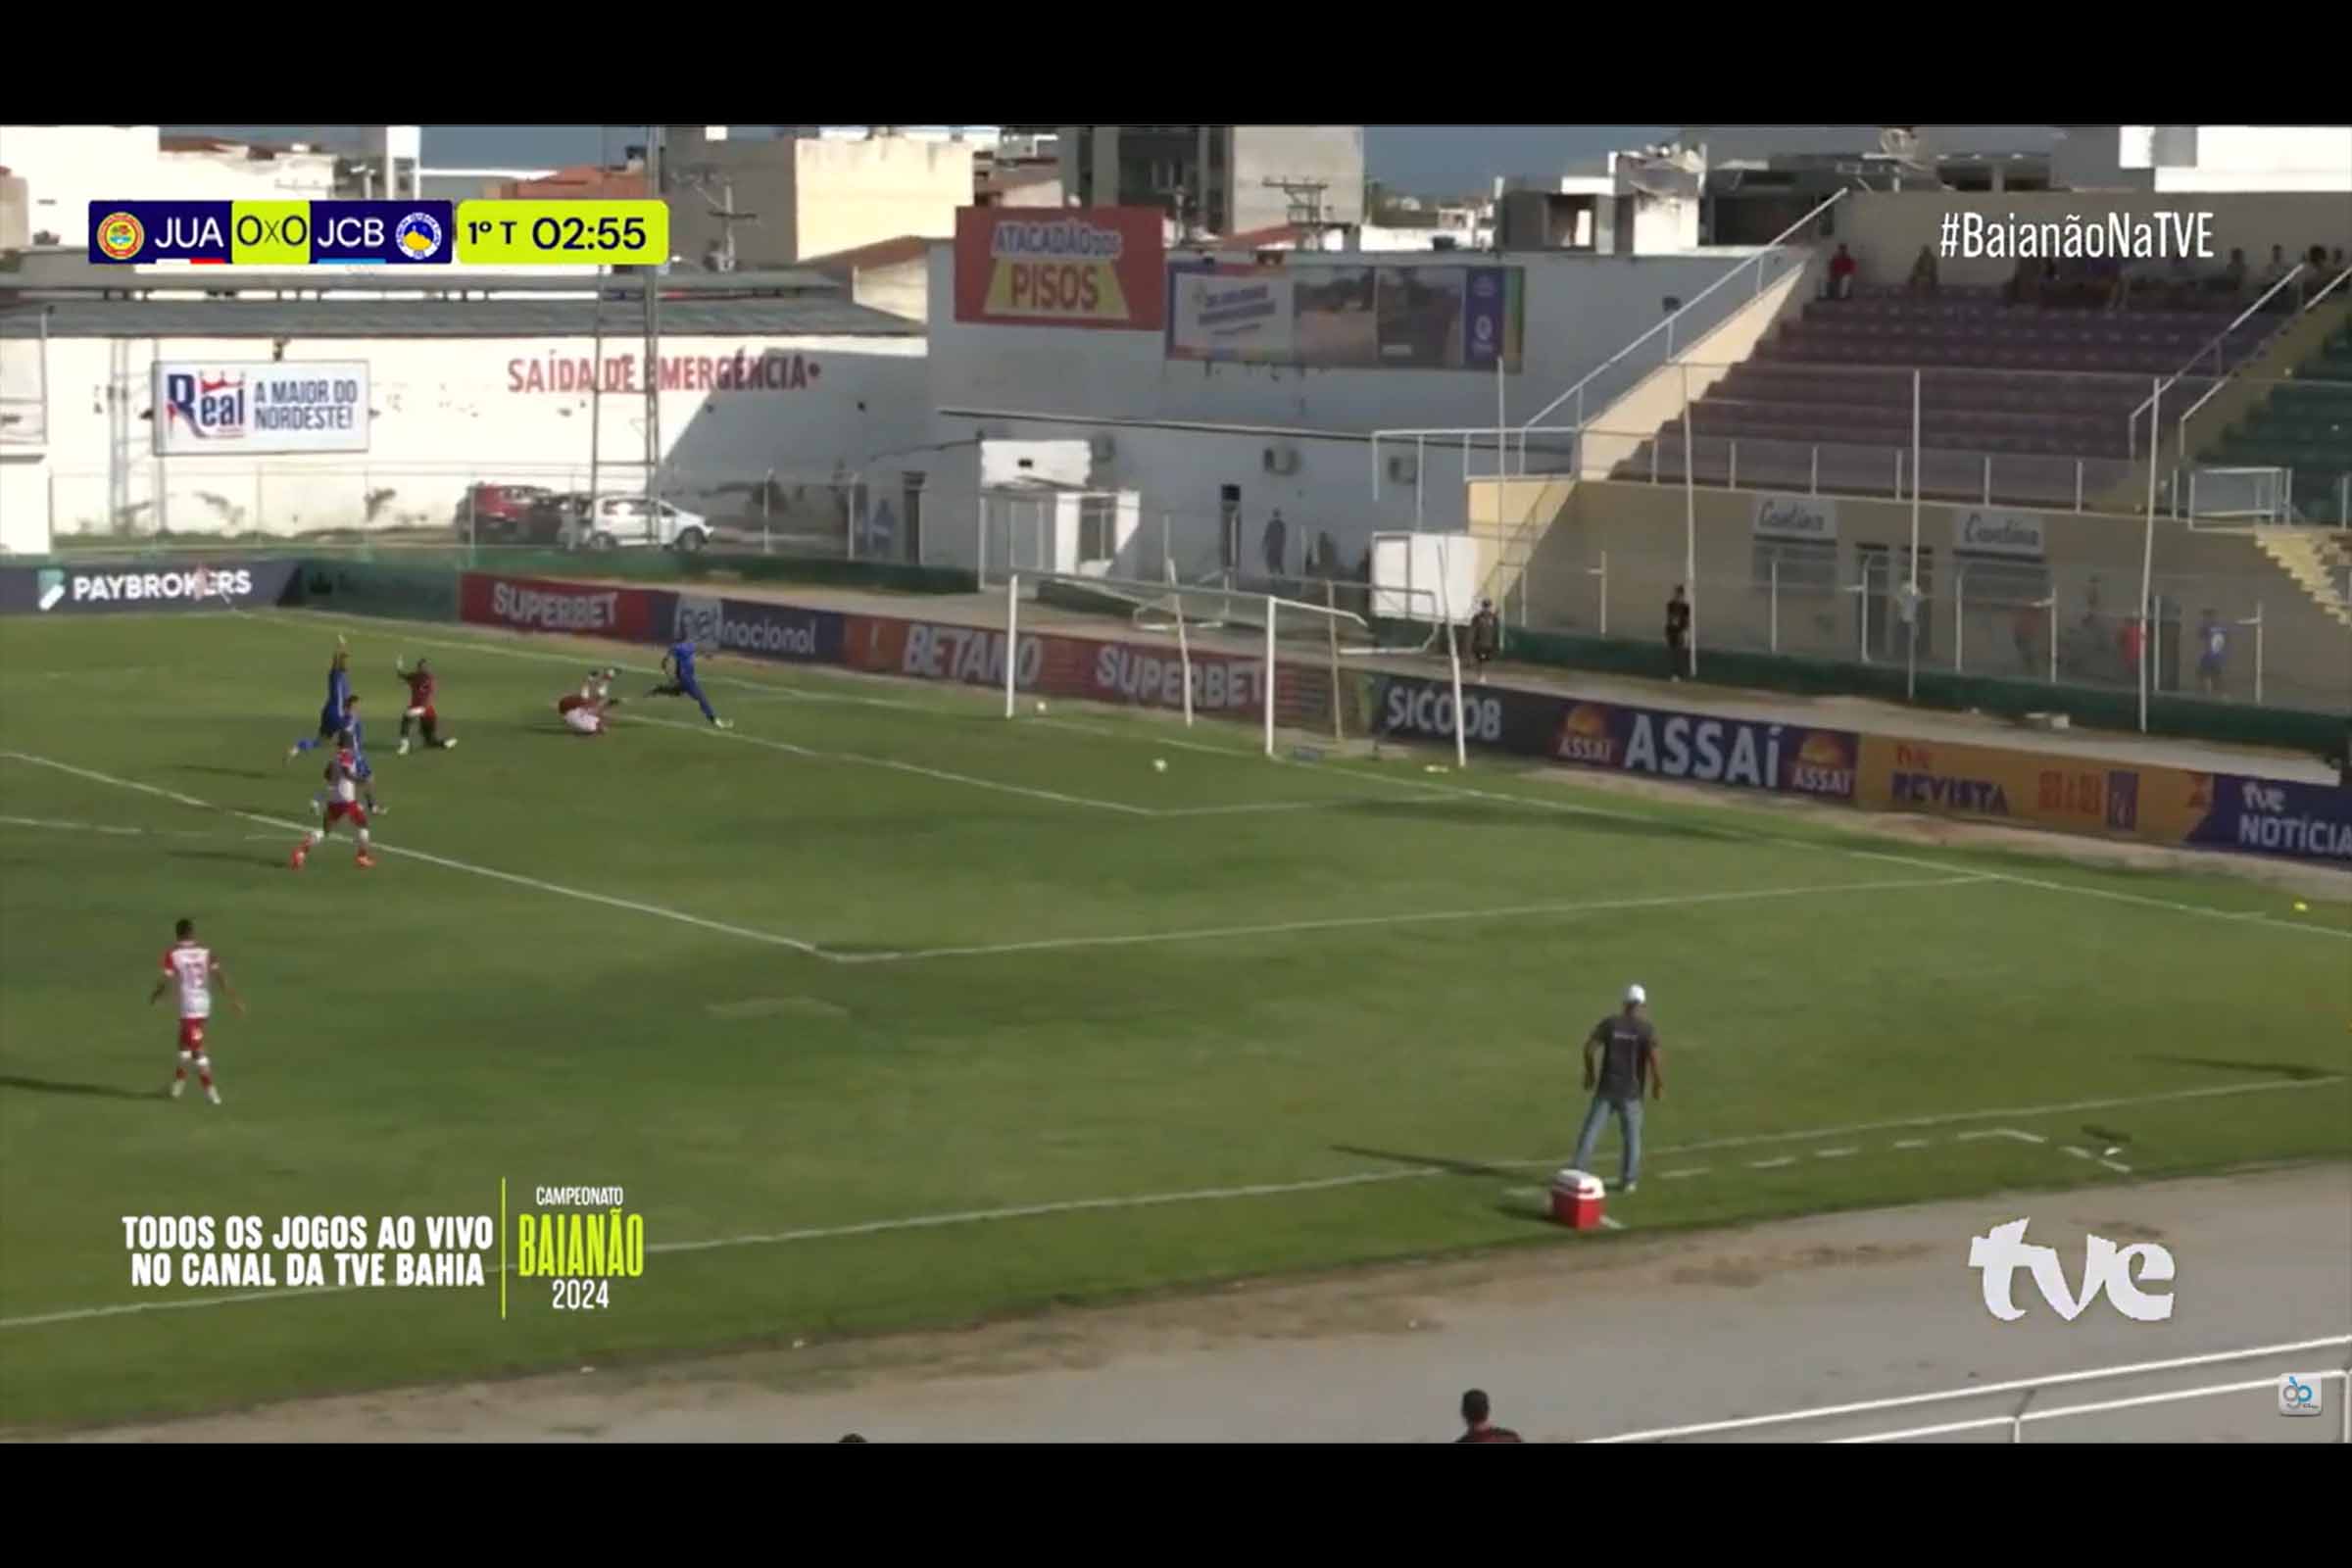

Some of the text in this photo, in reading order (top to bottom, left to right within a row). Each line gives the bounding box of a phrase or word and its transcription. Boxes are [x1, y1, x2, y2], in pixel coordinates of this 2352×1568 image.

[1010, 263, 1100, 311] PISOS
[253, 379, 359, 405] A MAIOR DO
[507, 352, 597, 393] SAÍDA
[604, 353, 635, 392] DE
[167, 373, 245, 438] Real
[253, 406, 353, 431] NORDESTE!
[492, 581, 619, 628] SUPERBET
[903, 621, 1044, 690] BETANO
[1095, 644, 1269, 708] SUPERBET
[1387, 685, 1502, 742] SICOOB
